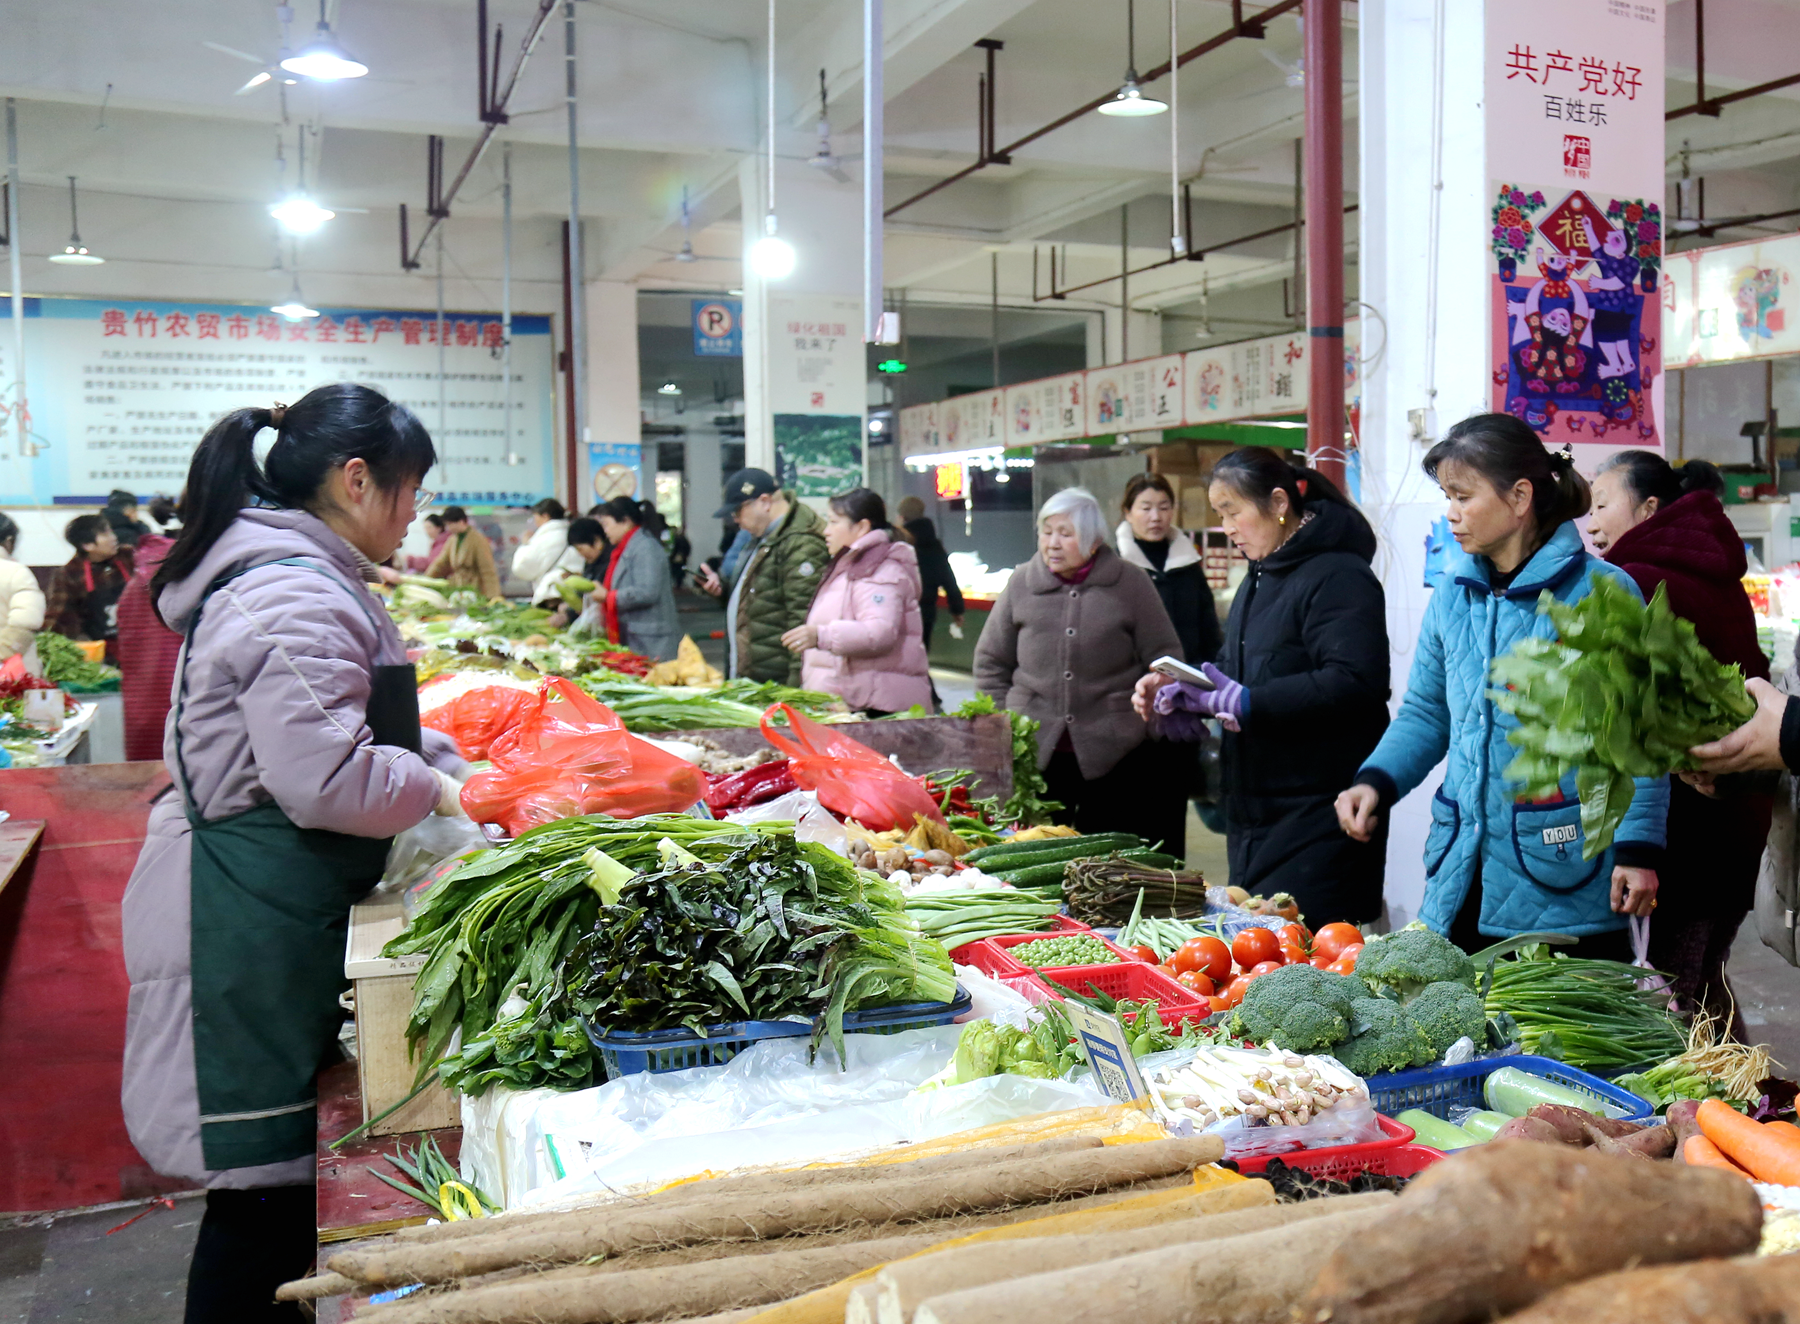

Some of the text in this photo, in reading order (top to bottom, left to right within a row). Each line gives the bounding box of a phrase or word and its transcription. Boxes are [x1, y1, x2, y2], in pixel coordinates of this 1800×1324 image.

[1505, 44, 1643, 101] 共产党好
[1543, 94, 1608, 127] 百姓乐
[1555, 210, 1591, 248] 福
[100, 308, 504, 348] 贵竹农贸市场安全生产管理制度
[1545, 827, 1575, 842] YOU
